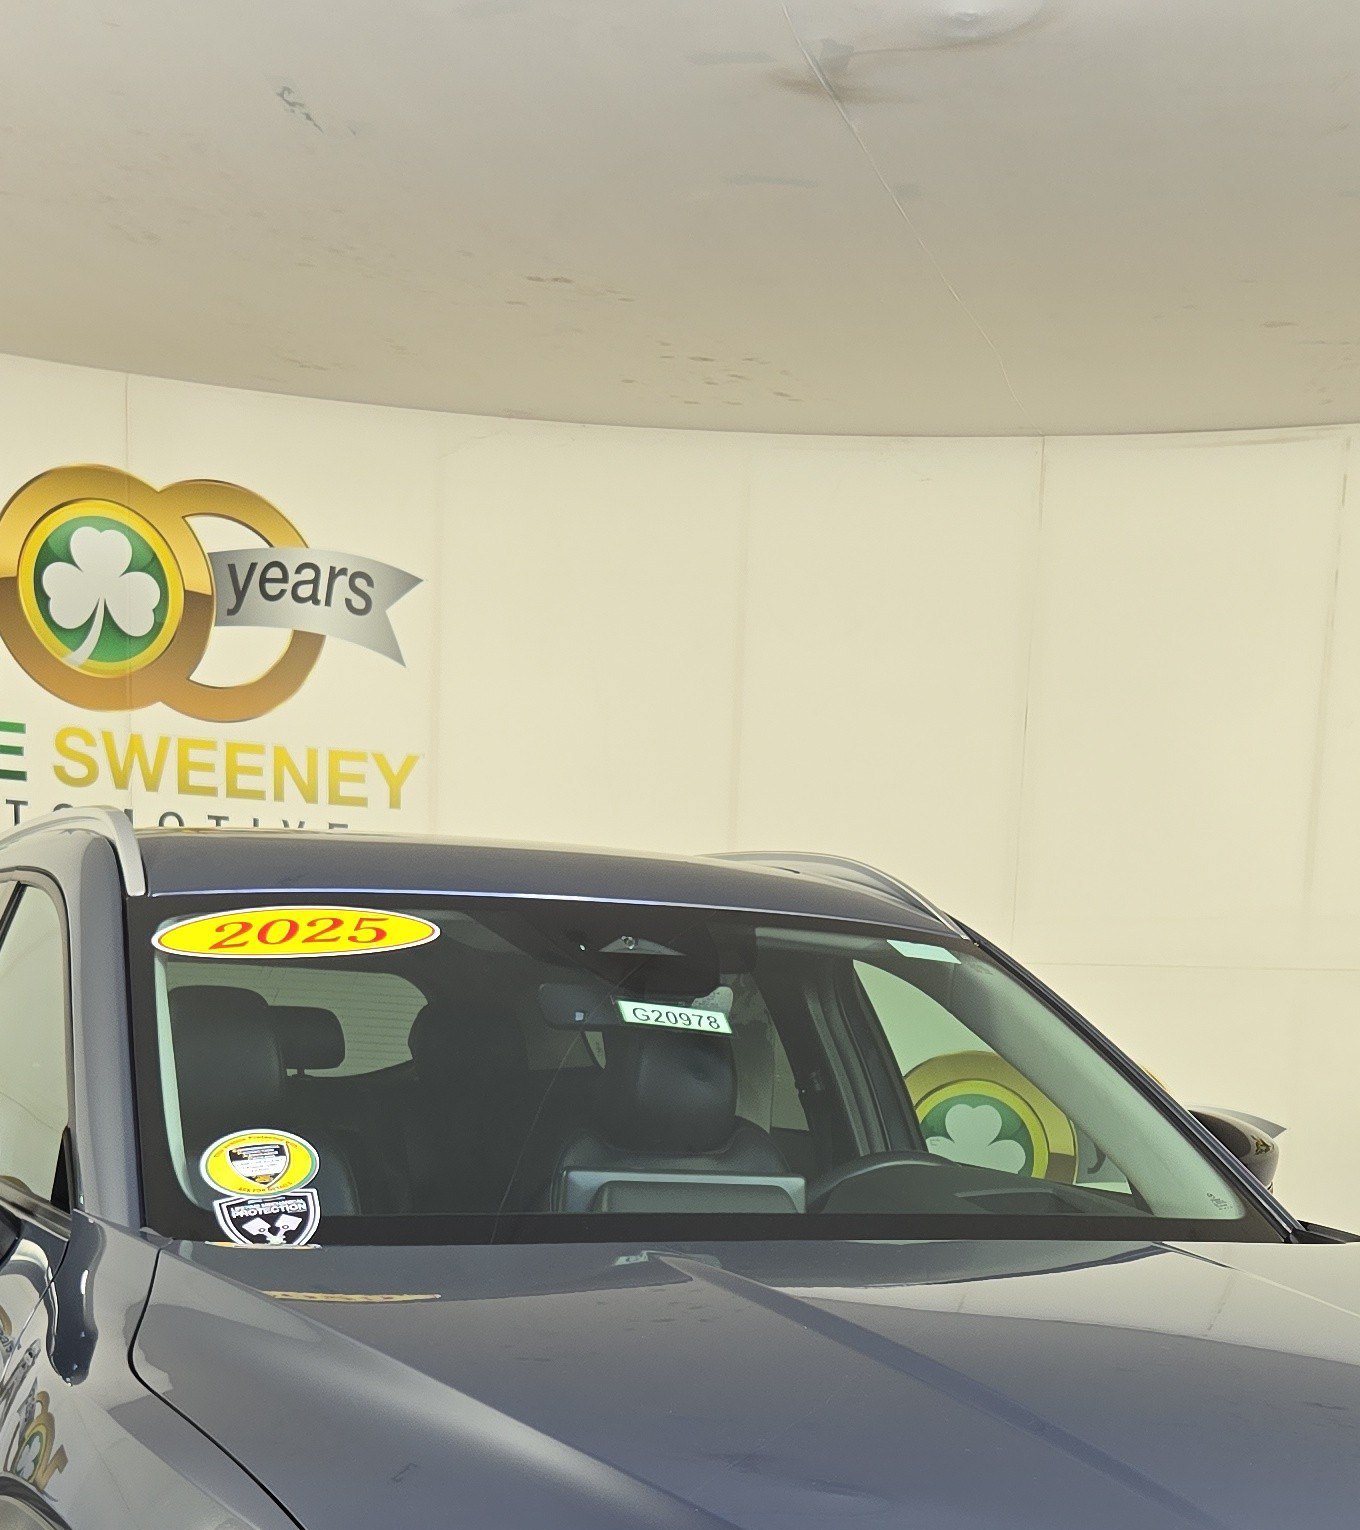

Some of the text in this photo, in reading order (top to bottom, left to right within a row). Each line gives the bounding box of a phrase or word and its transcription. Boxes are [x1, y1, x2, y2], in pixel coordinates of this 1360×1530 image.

[226, 560, 376, 617] years
[52, 726, 420, 811] SWEENEY
[208, 917, 390, 950] 2025
[632, 1007, 720, 1030] G20978
[231, 1202, 307, 1218] PROTECTION
